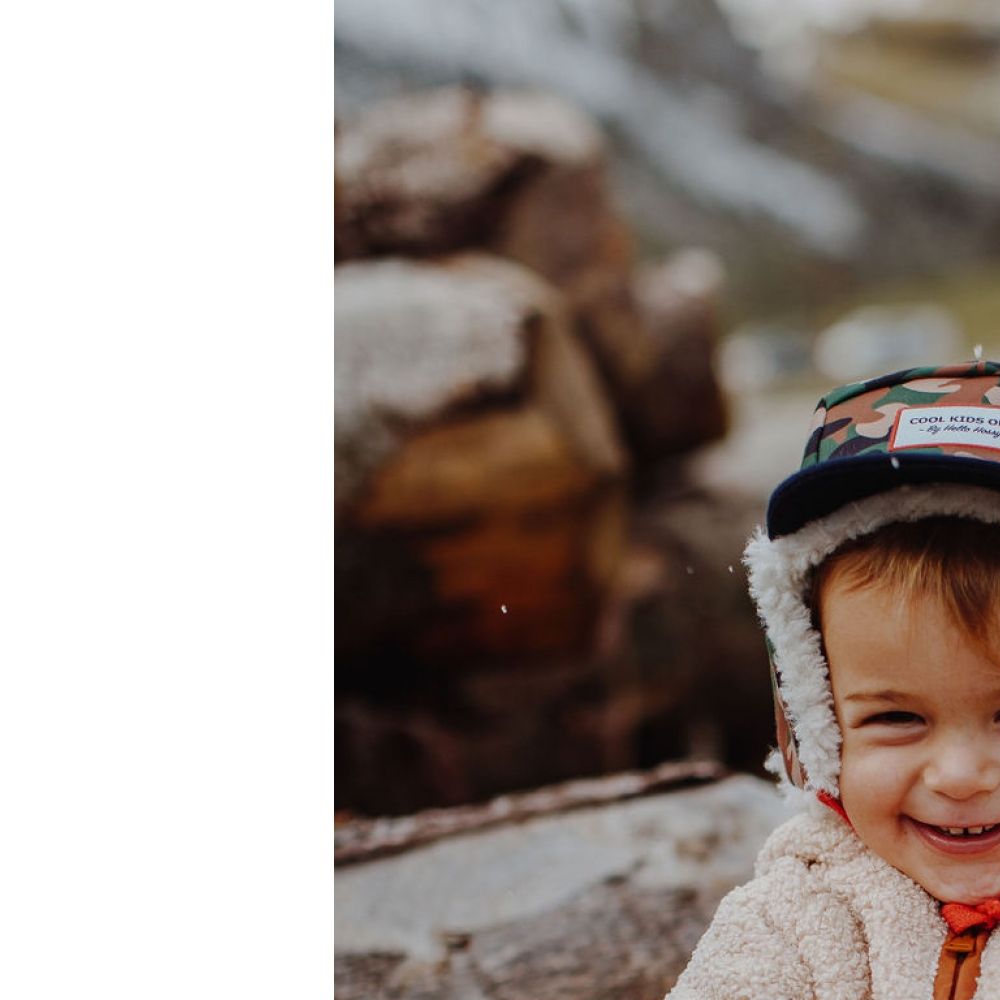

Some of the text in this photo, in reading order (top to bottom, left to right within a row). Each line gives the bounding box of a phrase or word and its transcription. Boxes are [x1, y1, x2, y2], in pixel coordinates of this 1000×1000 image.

[909, 416, 946, 425] COOL
[950, 415, 985, 424] KIDS
[927, 424, 940, 435] By
[943, 424, 971, 432] Hello
